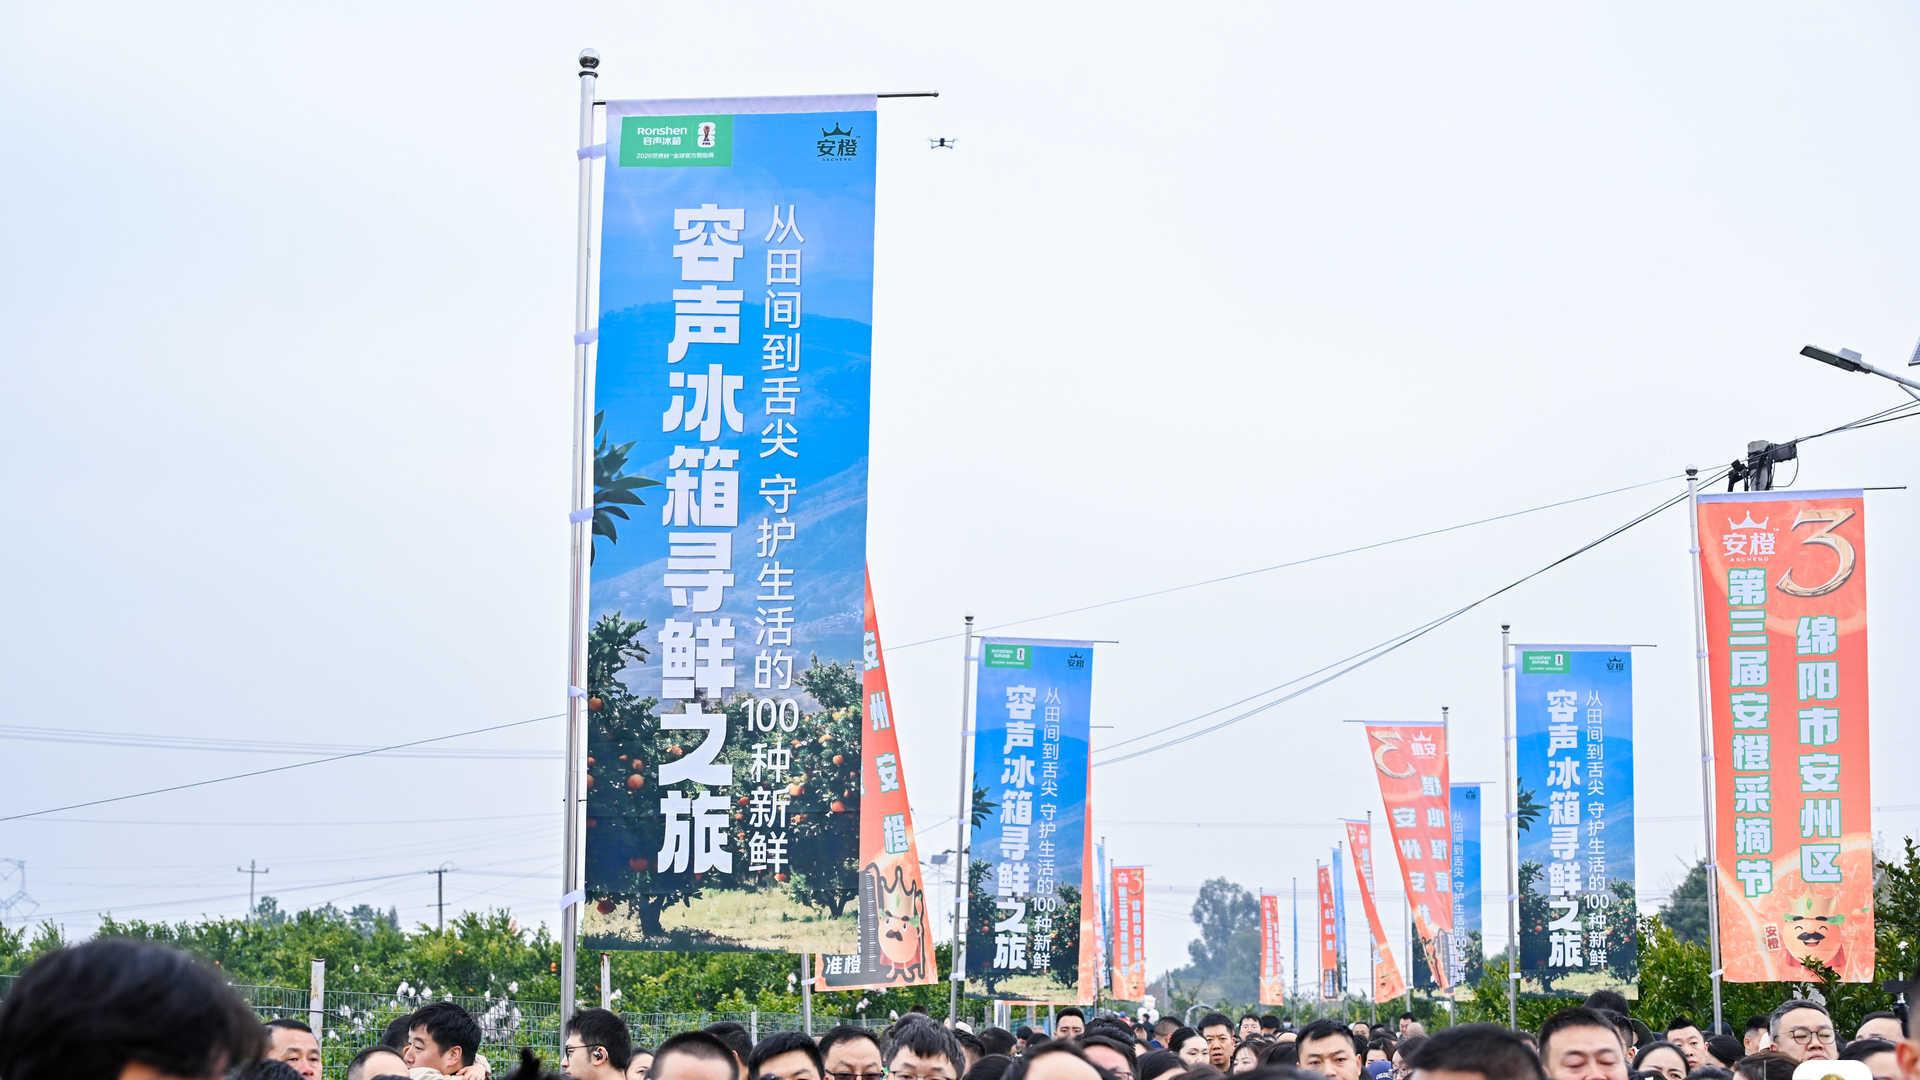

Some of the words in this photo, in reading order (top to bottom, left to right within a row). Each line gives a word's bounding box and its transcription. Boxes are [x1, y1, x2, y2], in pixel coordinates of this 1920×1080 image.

[637, 125, 687, 136] Ronshen
[816, 139, 858, 157] 安橙
[759, 203, 806, 459] 从田间到舌尖
[657, 203, 745, 874] 容声冰箱寻鲜之旅
[1722, 532, 1776, 557] 安橙
[1775, 507, 1856, 597] 3
[740, 473, 799, 873] 守护生活的100种新鲜
[1041, 687, 1061, 798] 从田间到舌尖
[1586, 690, 1605, 797] 从田间到舌尖
[1727, 567, 1772, 898] 第三届安橙采摘节
[1796, 615, 1842, 884] 绵阳市安州区
[993, 684, 1037, 970] 容声冰箱寻鲜之旅
[1031, 803, 1057, 970] 守护生活的100种新鲜
[1546, 689, 1583, 968] 容声冰箱寻鲜之旅
[1583, 801, 1609, 969] 守护生活的100种新鲜
